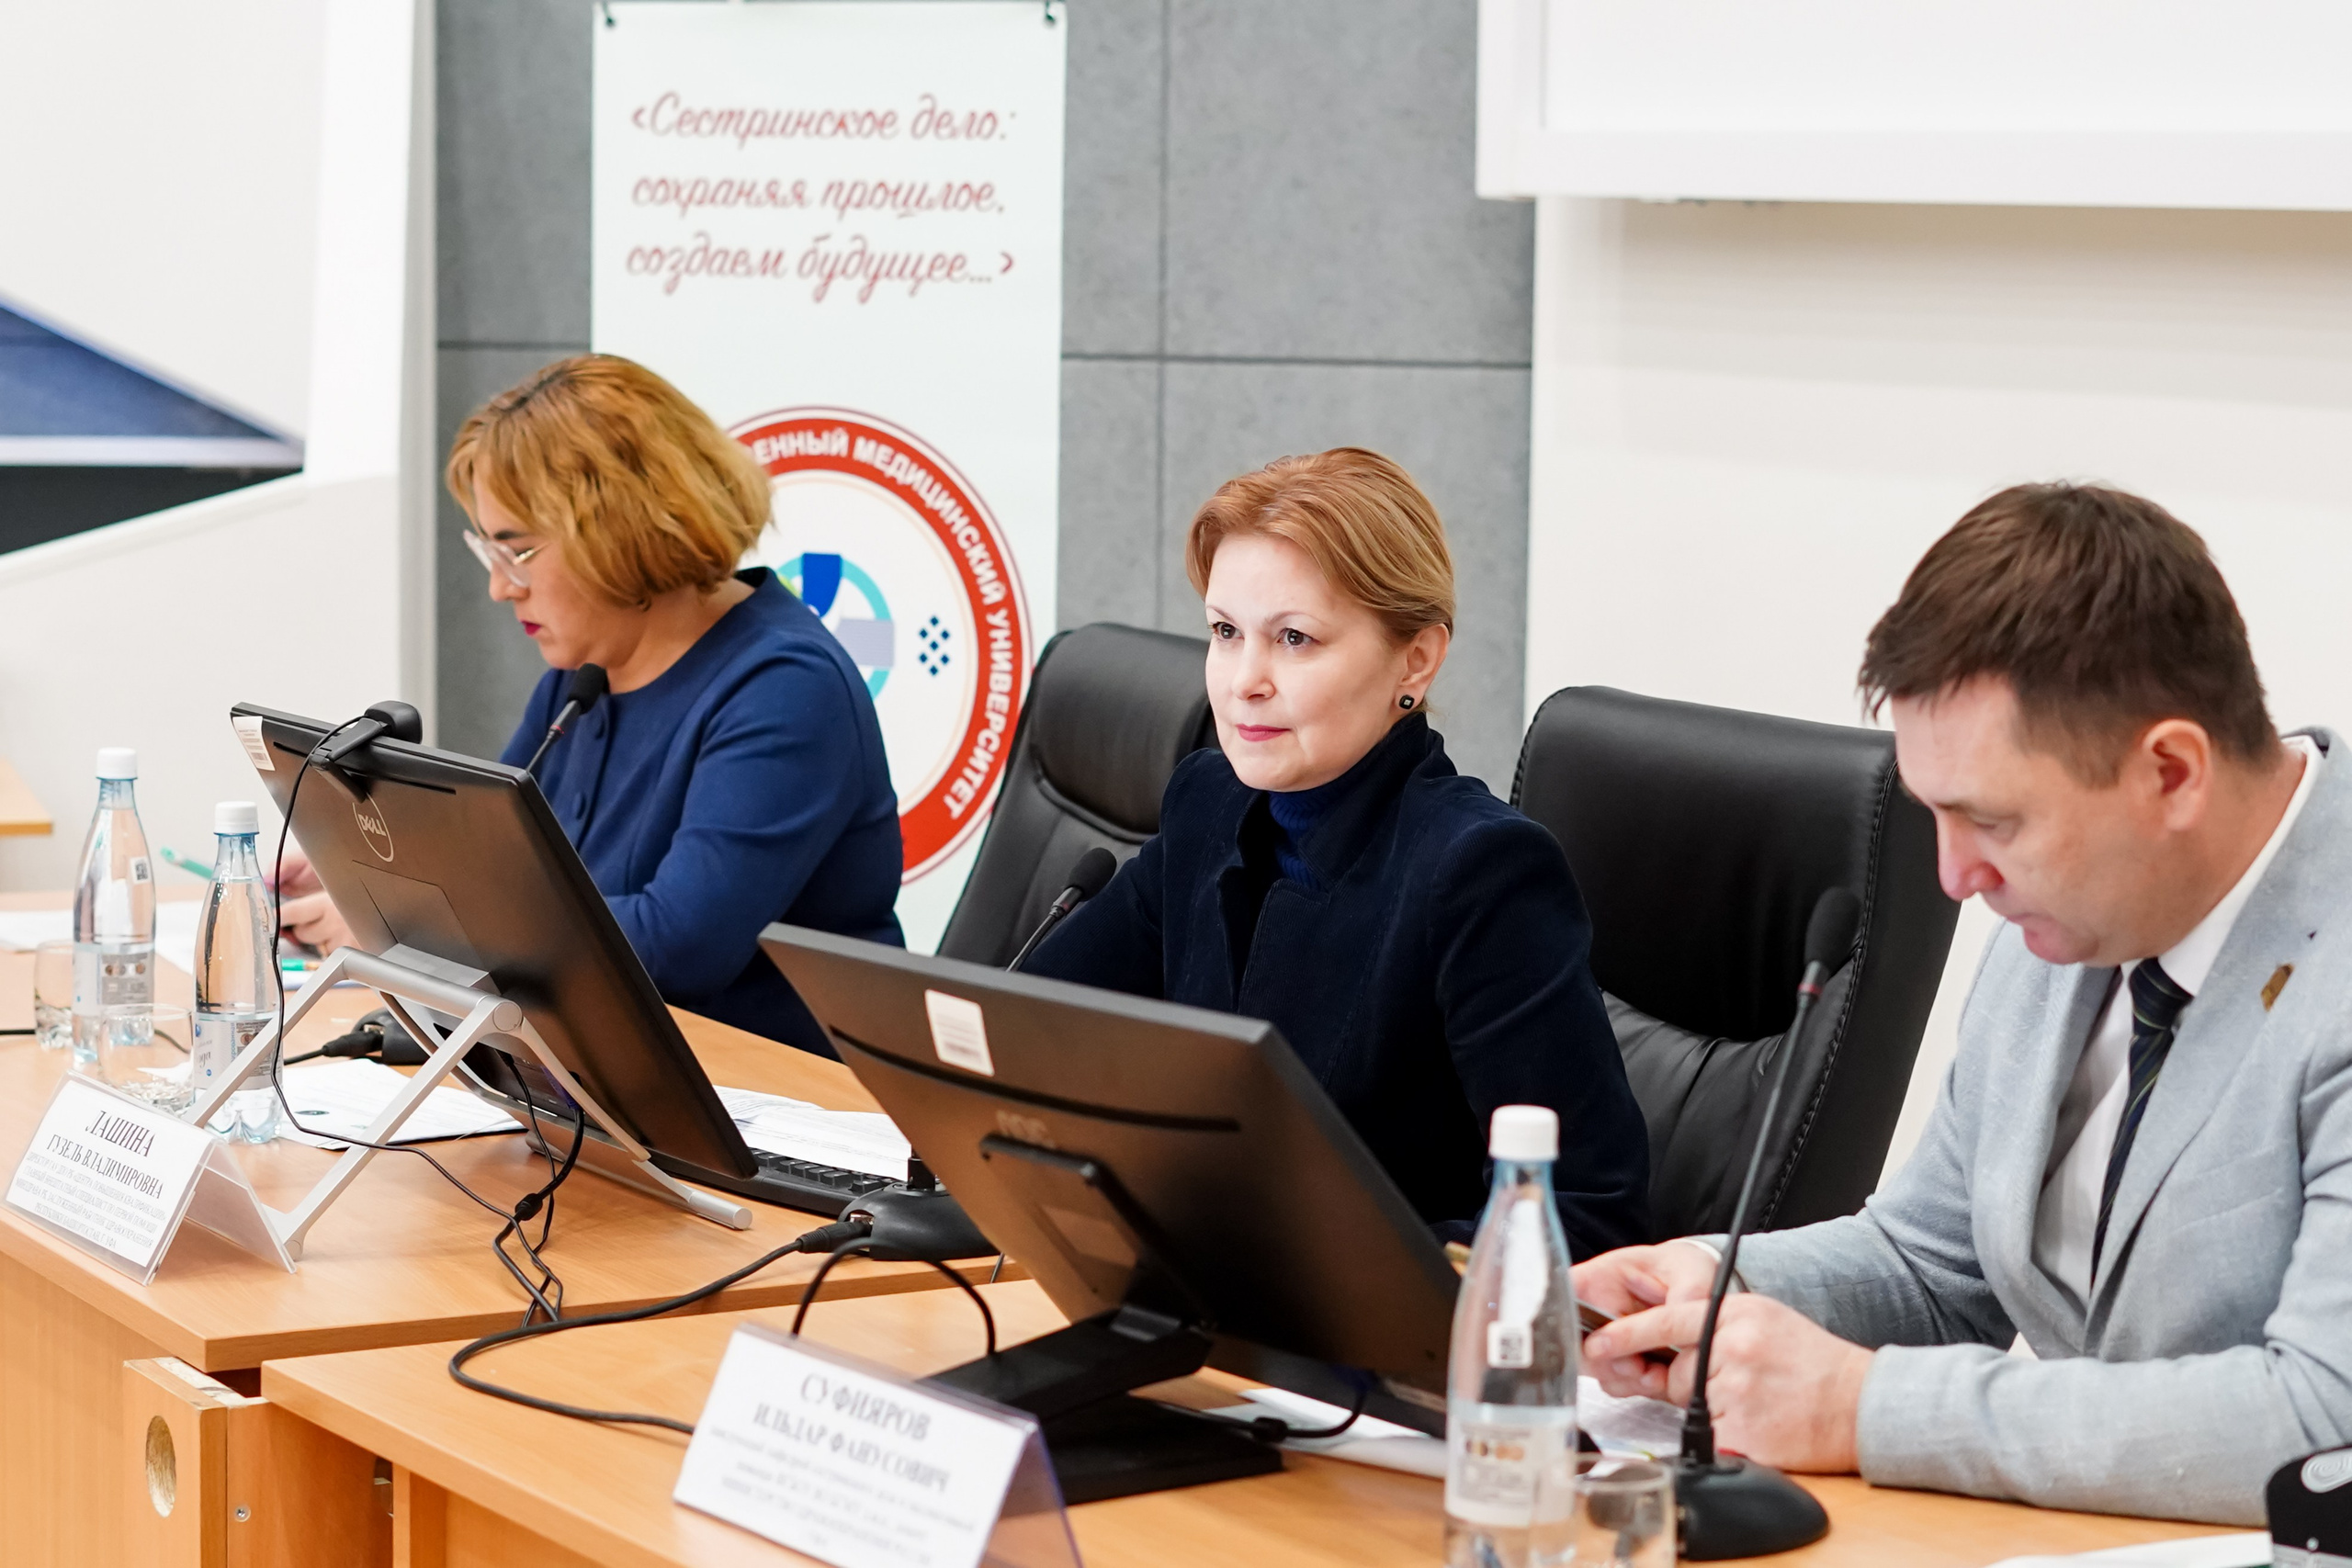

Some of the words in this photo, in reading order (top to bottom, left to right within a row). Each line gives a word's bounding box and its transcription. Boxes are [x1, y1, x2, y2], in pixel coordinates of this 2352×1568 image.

[911, 93, 1017, 141] дело:
[632, 176, 808, 219] сохраняя
[626, 230, 786, 296] создаем
[750, 426, 850, 466] ЕННЫЙ
[852, 435, 1009, 605] МЕДИЦИНСКИЙ
[943, 607, 1013, 820] УНИВЕРСИТЕТ
[357, 813, 387, 837] DELL
[85, 1110, 156, 1157] ЛАШИНА
[46, 1134, 83, 1164] ГУЗЕЛЬ
[81, 1148, 164, 1200] ВЛАДИМИРОВНА
[800, 1373, 932, 1441] СУФИЯРОВ
